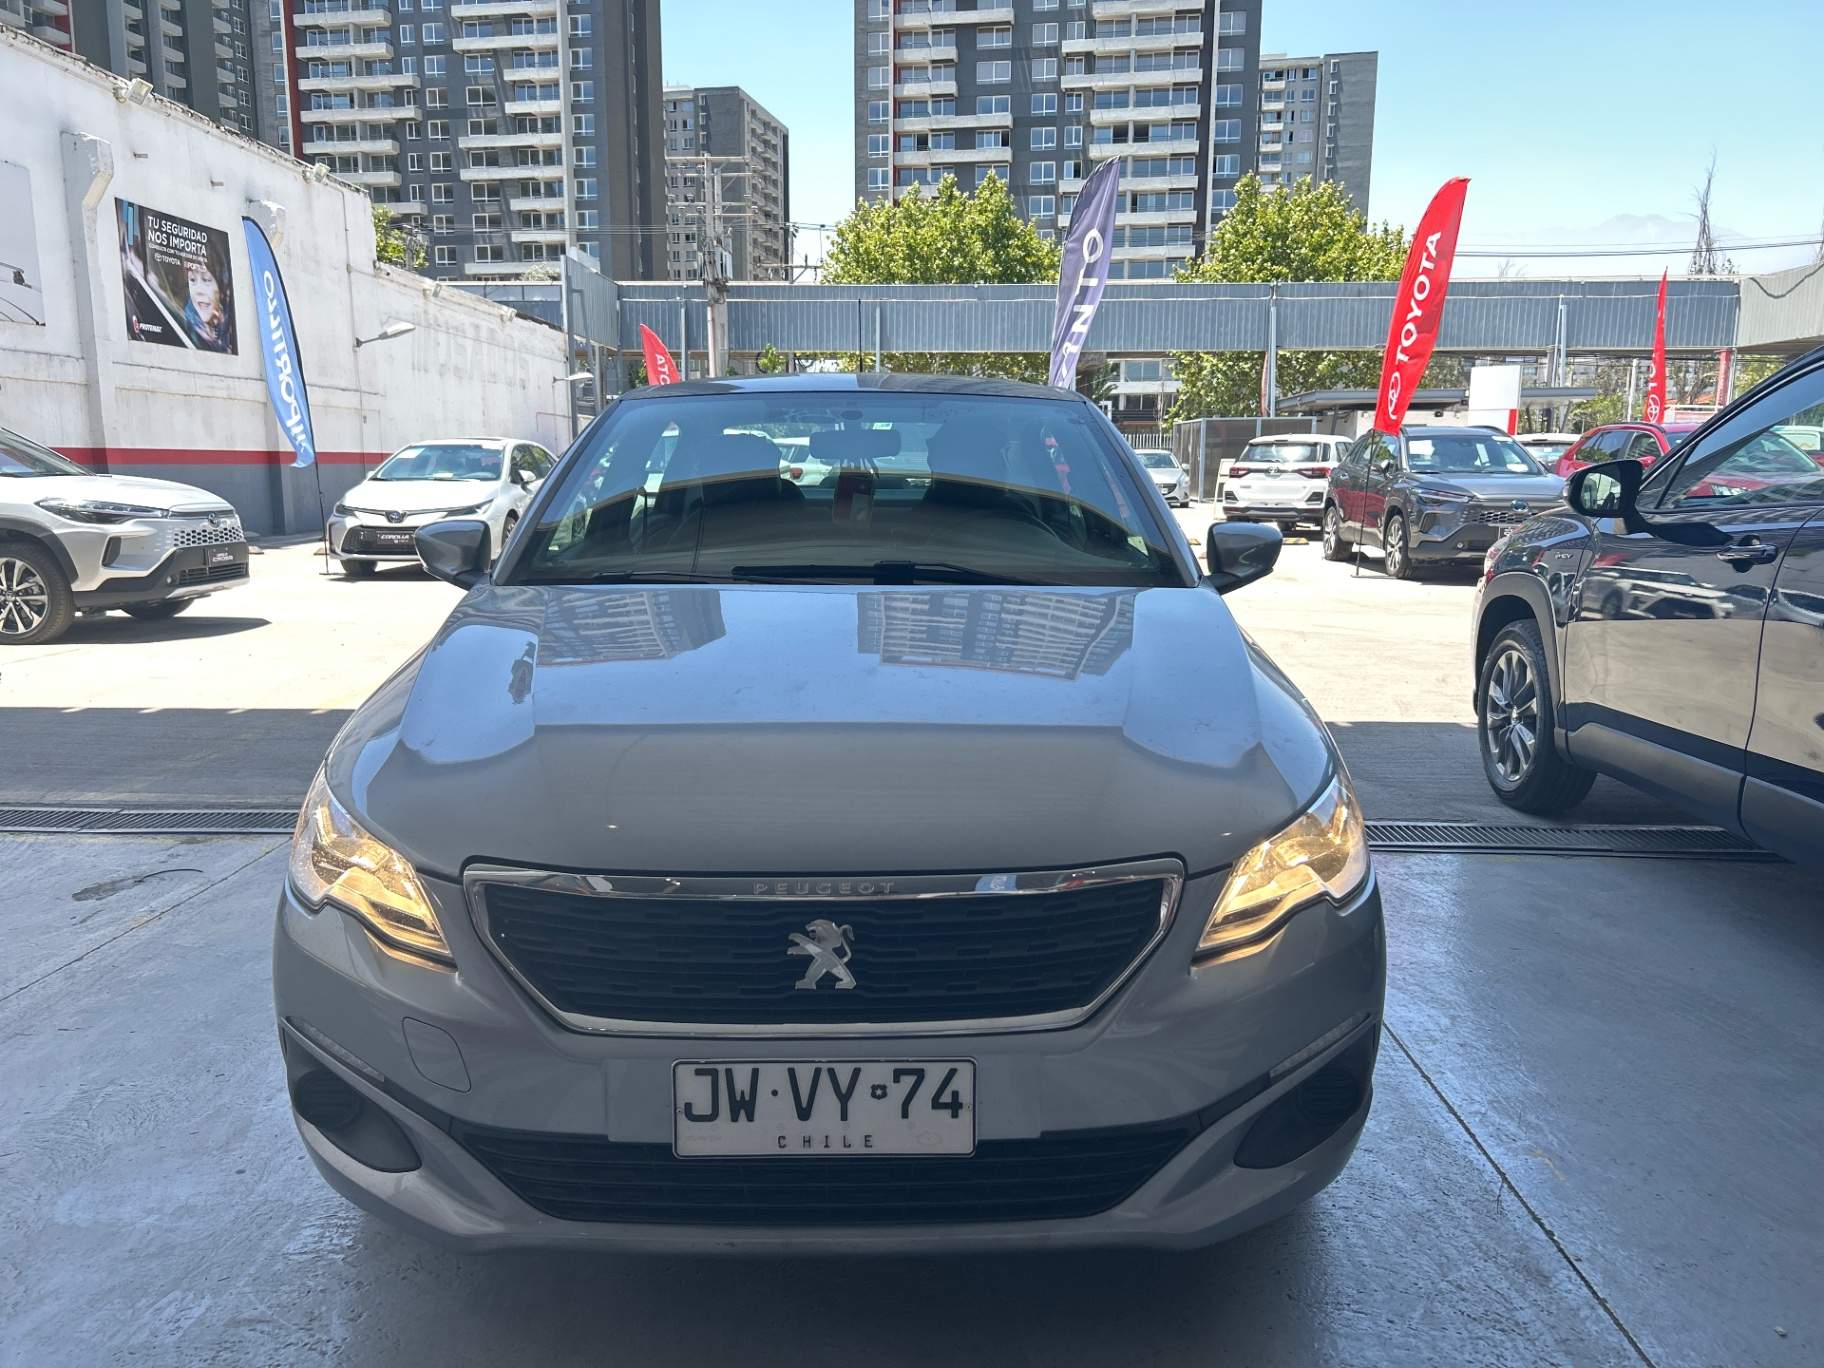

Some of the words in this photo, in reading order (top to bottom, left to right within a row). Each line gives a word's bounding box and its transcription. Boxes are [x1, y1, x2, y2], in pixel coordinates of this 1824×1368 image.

[148, 216, 160, 229] TU
[161, 220, 208, 243] SEGURIDAD
[148, 229, 168, 246] NOS
[169, 234, 207, 257] IMPORTA
[162, 255, 181, 266] TOYOTA
[1395, 231, 1442, 365] TOYOTA
[753, 880, 895, 895] PEUGEOT
[777, 1134, 873, 1149] CHILE
